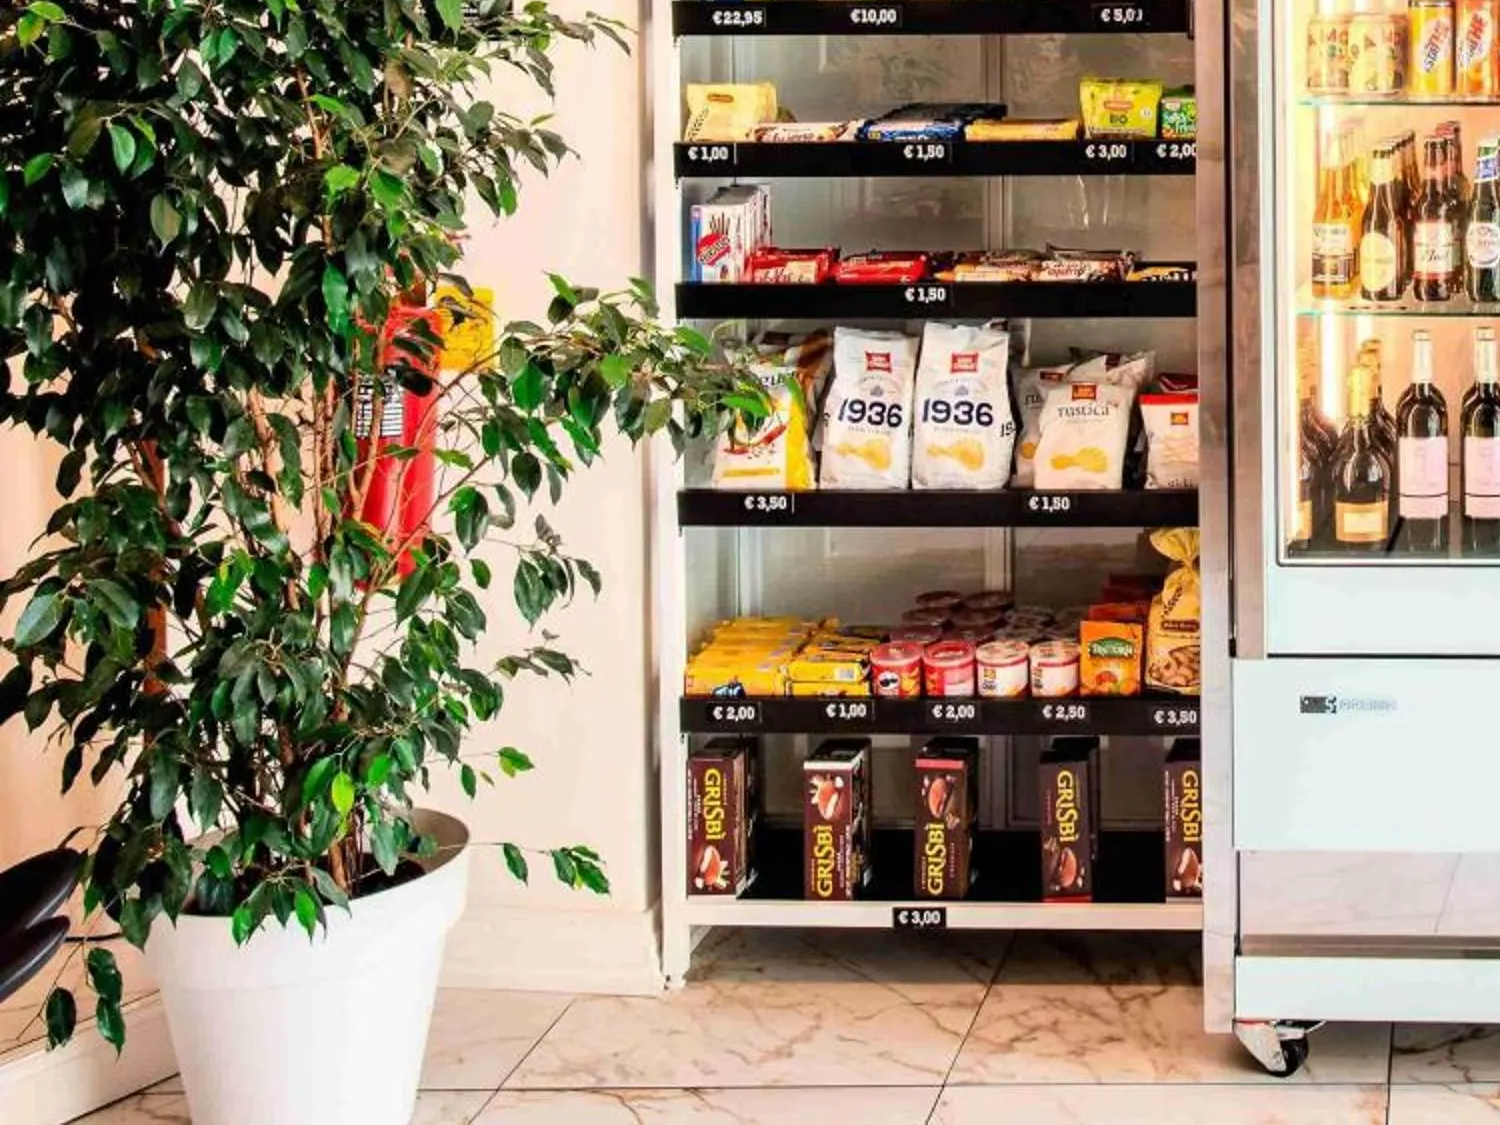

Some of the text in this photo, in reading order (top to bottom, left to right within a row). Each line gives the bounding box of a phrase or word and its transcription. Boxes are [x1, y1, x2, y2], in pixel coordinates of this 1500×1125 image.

[1101, 8, 1111, 22] €
[688, 146, 728, 162] € 1,00
[903, 144, 945, 161] € 1,50
[1085, 144, 1127, 161] € 3,00
[1156, 144, 1167, 158] €
[904, 287, 946, 303] € 1,50
[838, 398, 903, 427] 1936
[922, 398, 994, 426] 1936
[744, 496, 787, 512] € 3,50
[1028, 496, 1070, 513] € 1,50
[712, 706, 755, 722] € 2,00
[825, 704, 867, 720] € 1,00
[931, 704, 975, 721] € 2,00
[1042, 704, 1085, 721] € 2,50
[1153, 710, 1197, 725] € 3,50
[898, 911, 941, 926] € 3,00
